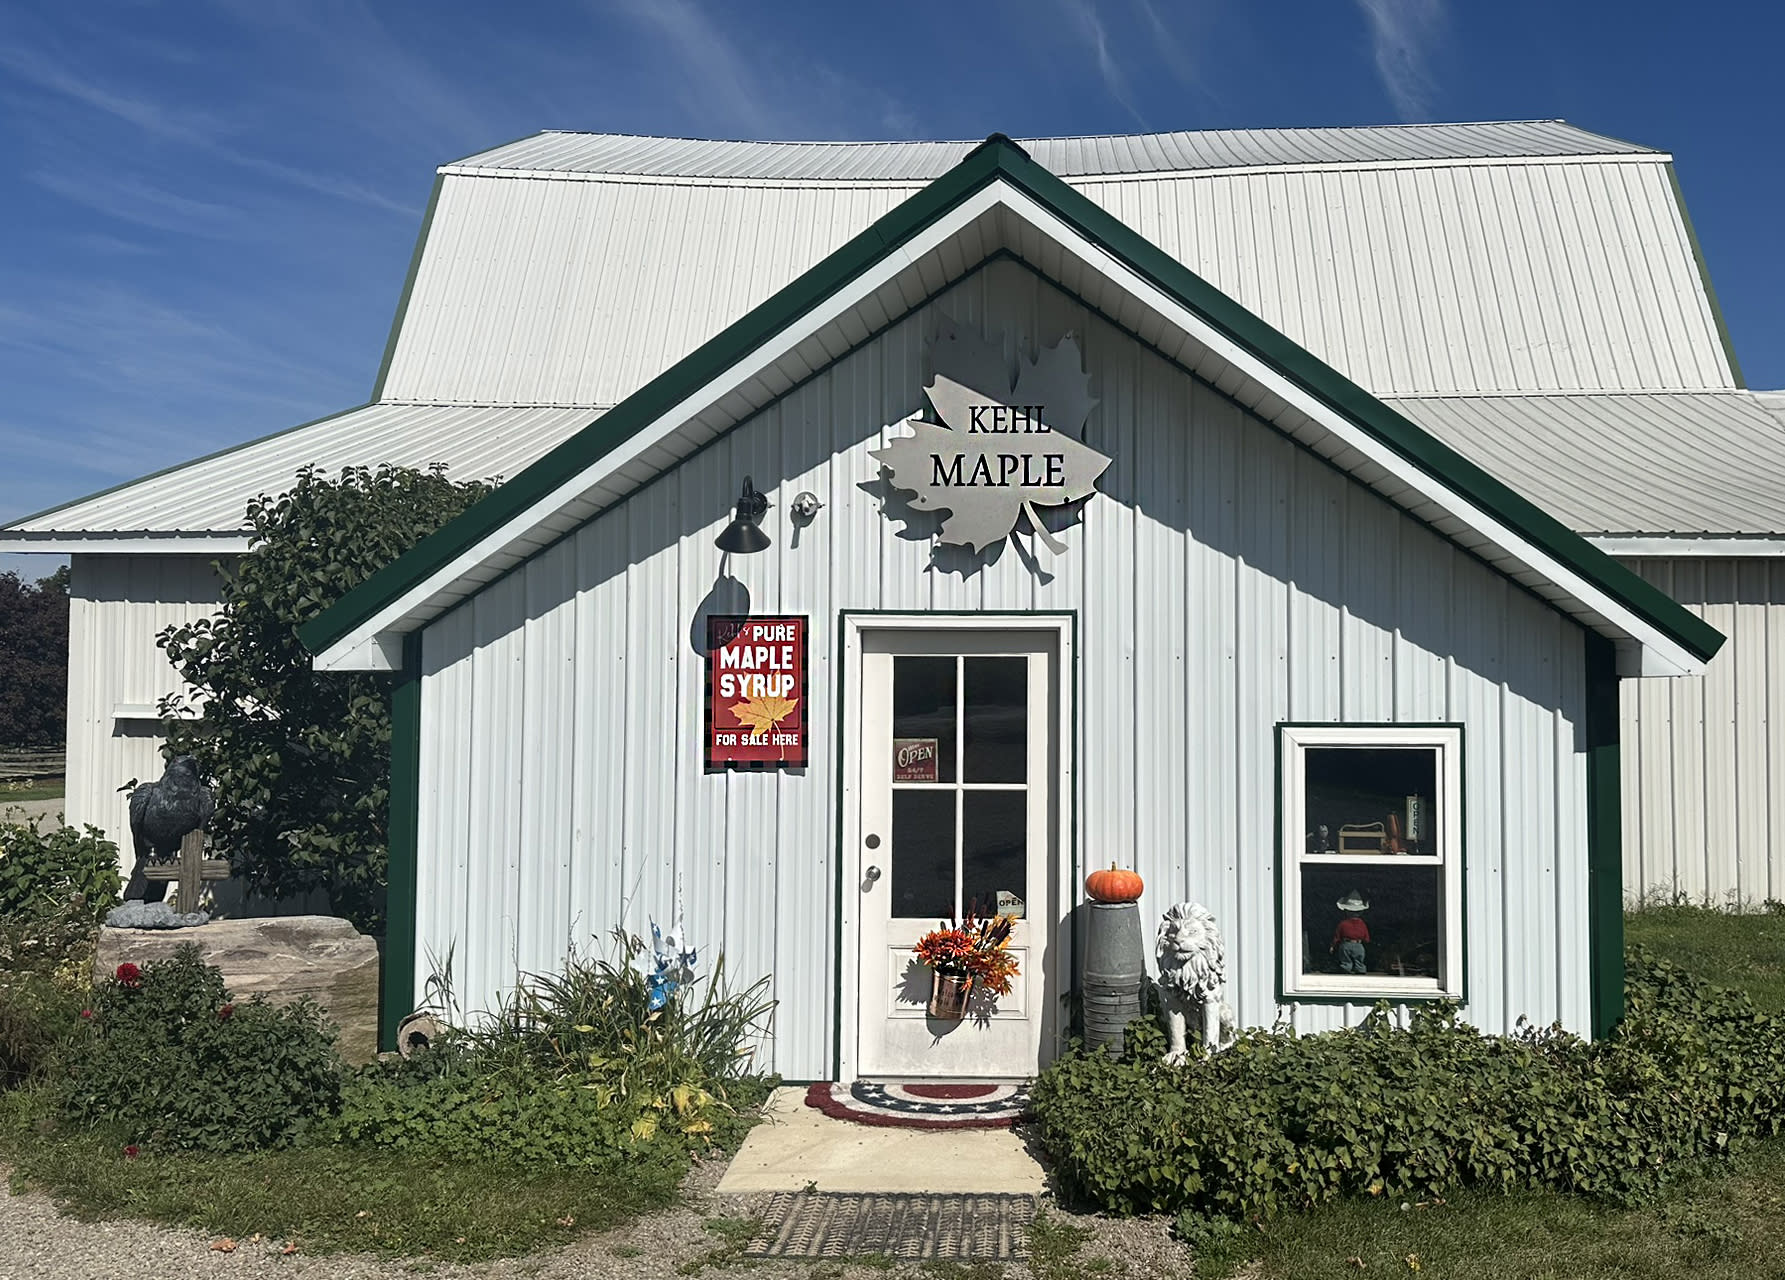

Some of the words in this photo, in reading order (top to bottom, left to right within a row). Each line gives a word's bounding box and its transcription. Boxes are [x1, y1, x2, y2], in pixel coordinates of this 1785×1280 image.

[968, 406, 1051, 434] KEHL
[930, 454, 1065, 487] MAPLE
[753, 625, 795, 642] PURE
[720, 646, 793, 670] MAPLE
[720, 673, 795, 698] SYRUP
[716, 734, 737, 746] FOR
[741, 734, 769, 746] SALE
[772, 734, 799, 746] HERE
[898, 746, 933, 768] OPEN
